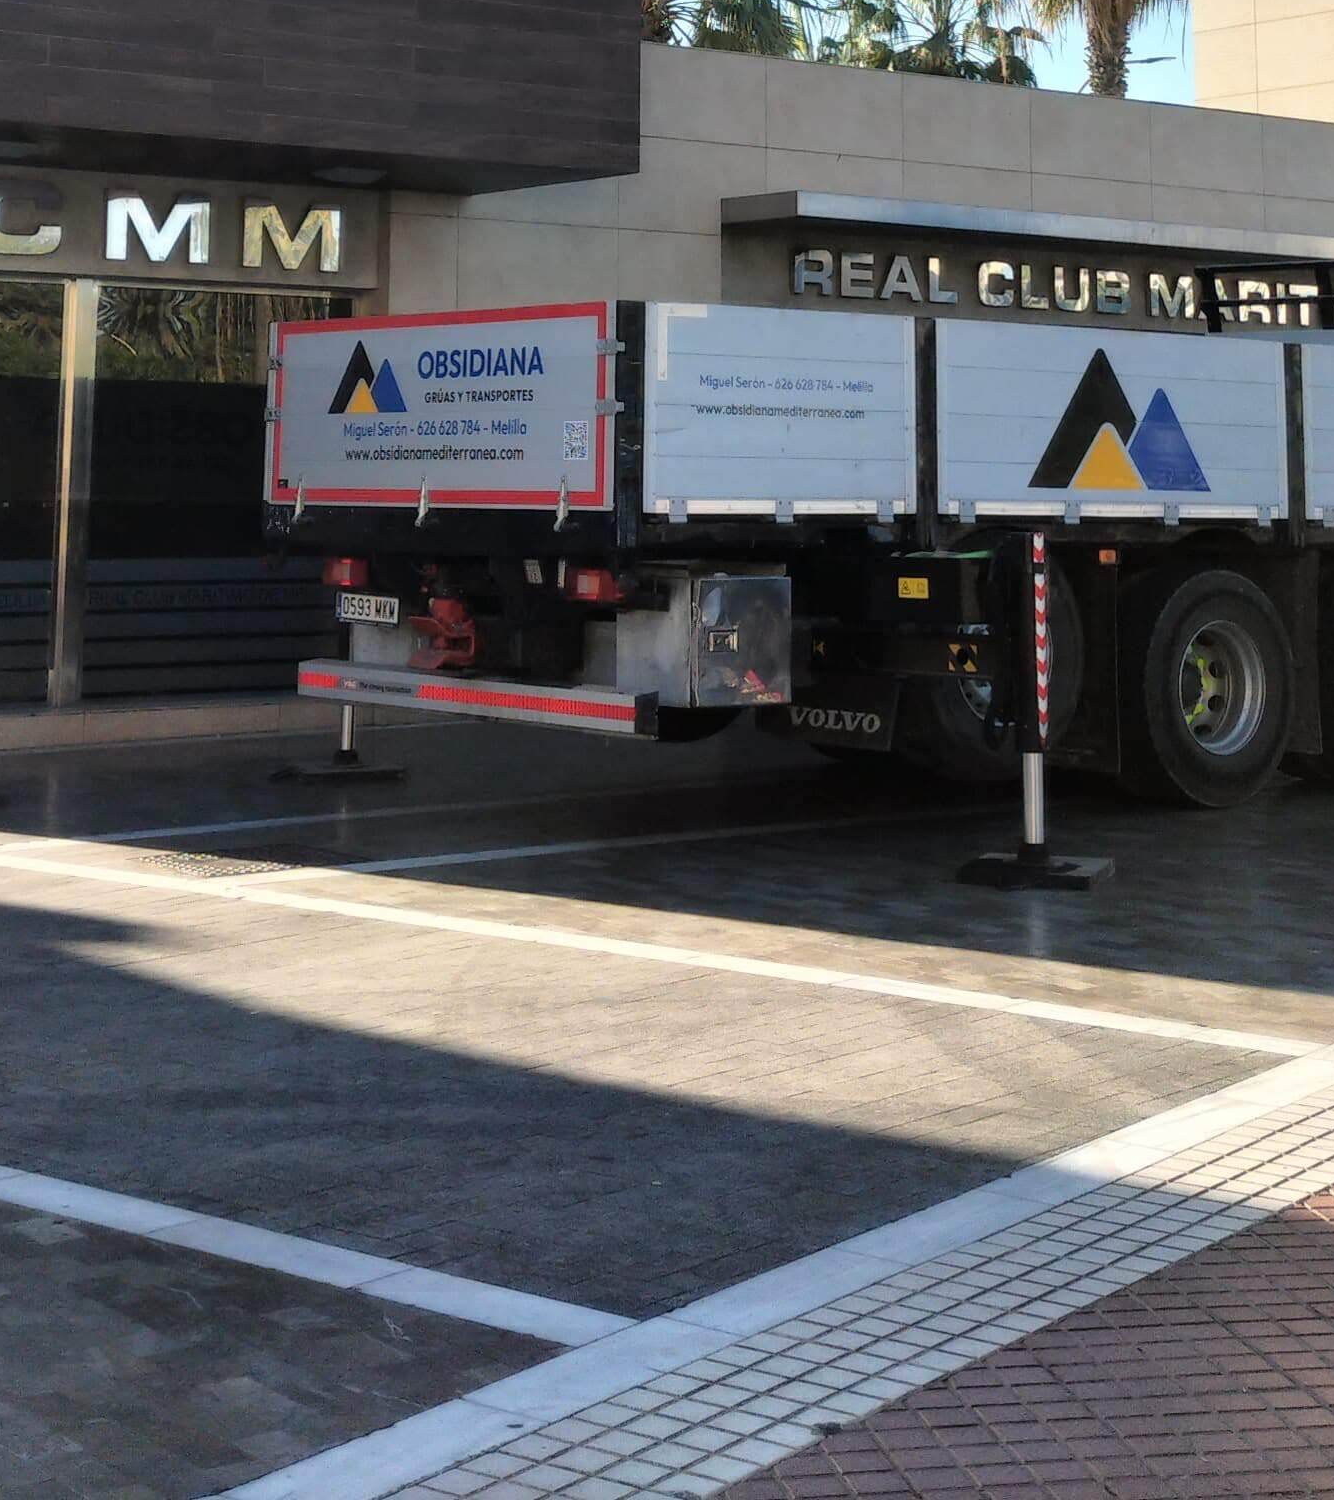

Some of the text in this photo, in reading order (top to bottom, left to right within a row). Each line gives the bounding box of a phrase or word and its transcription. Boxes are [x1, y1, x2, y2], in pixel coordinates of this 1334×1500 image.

[793, 248, 959, 304] REAL
[978, 260, 1133, 315] CLUB
[417, 346, 545, 380] OBSIDIANA
[699, 374, 734, 391] Miguel
[736, 375, 766, 389] Serón
[774, 377, 794, 390] 626
[795, 378, 814, 391] 628
[815, 379, 834, 392] 784
[843, 380, 874, 393] Melilla
[424, 388, 534, 404] GRÚAS Y TRANSPORTES
[696, 404, 865, 419] www.obsidianamediterranea.com
[343, 422, 376, 440] Miguel
[378, 421, 408, 437] Serón
[417, 421, 436, 436] 626
[438, 420, 458, 436] 628
[460, 419, 480, 435] 784
[491, 418, 527, 435] Melilla
[345, 444, 524, 461] www.obsidianamediterranea.com
[342, 596, 372, 617] 0593
[787, 705, 882, 733] VOLVO
